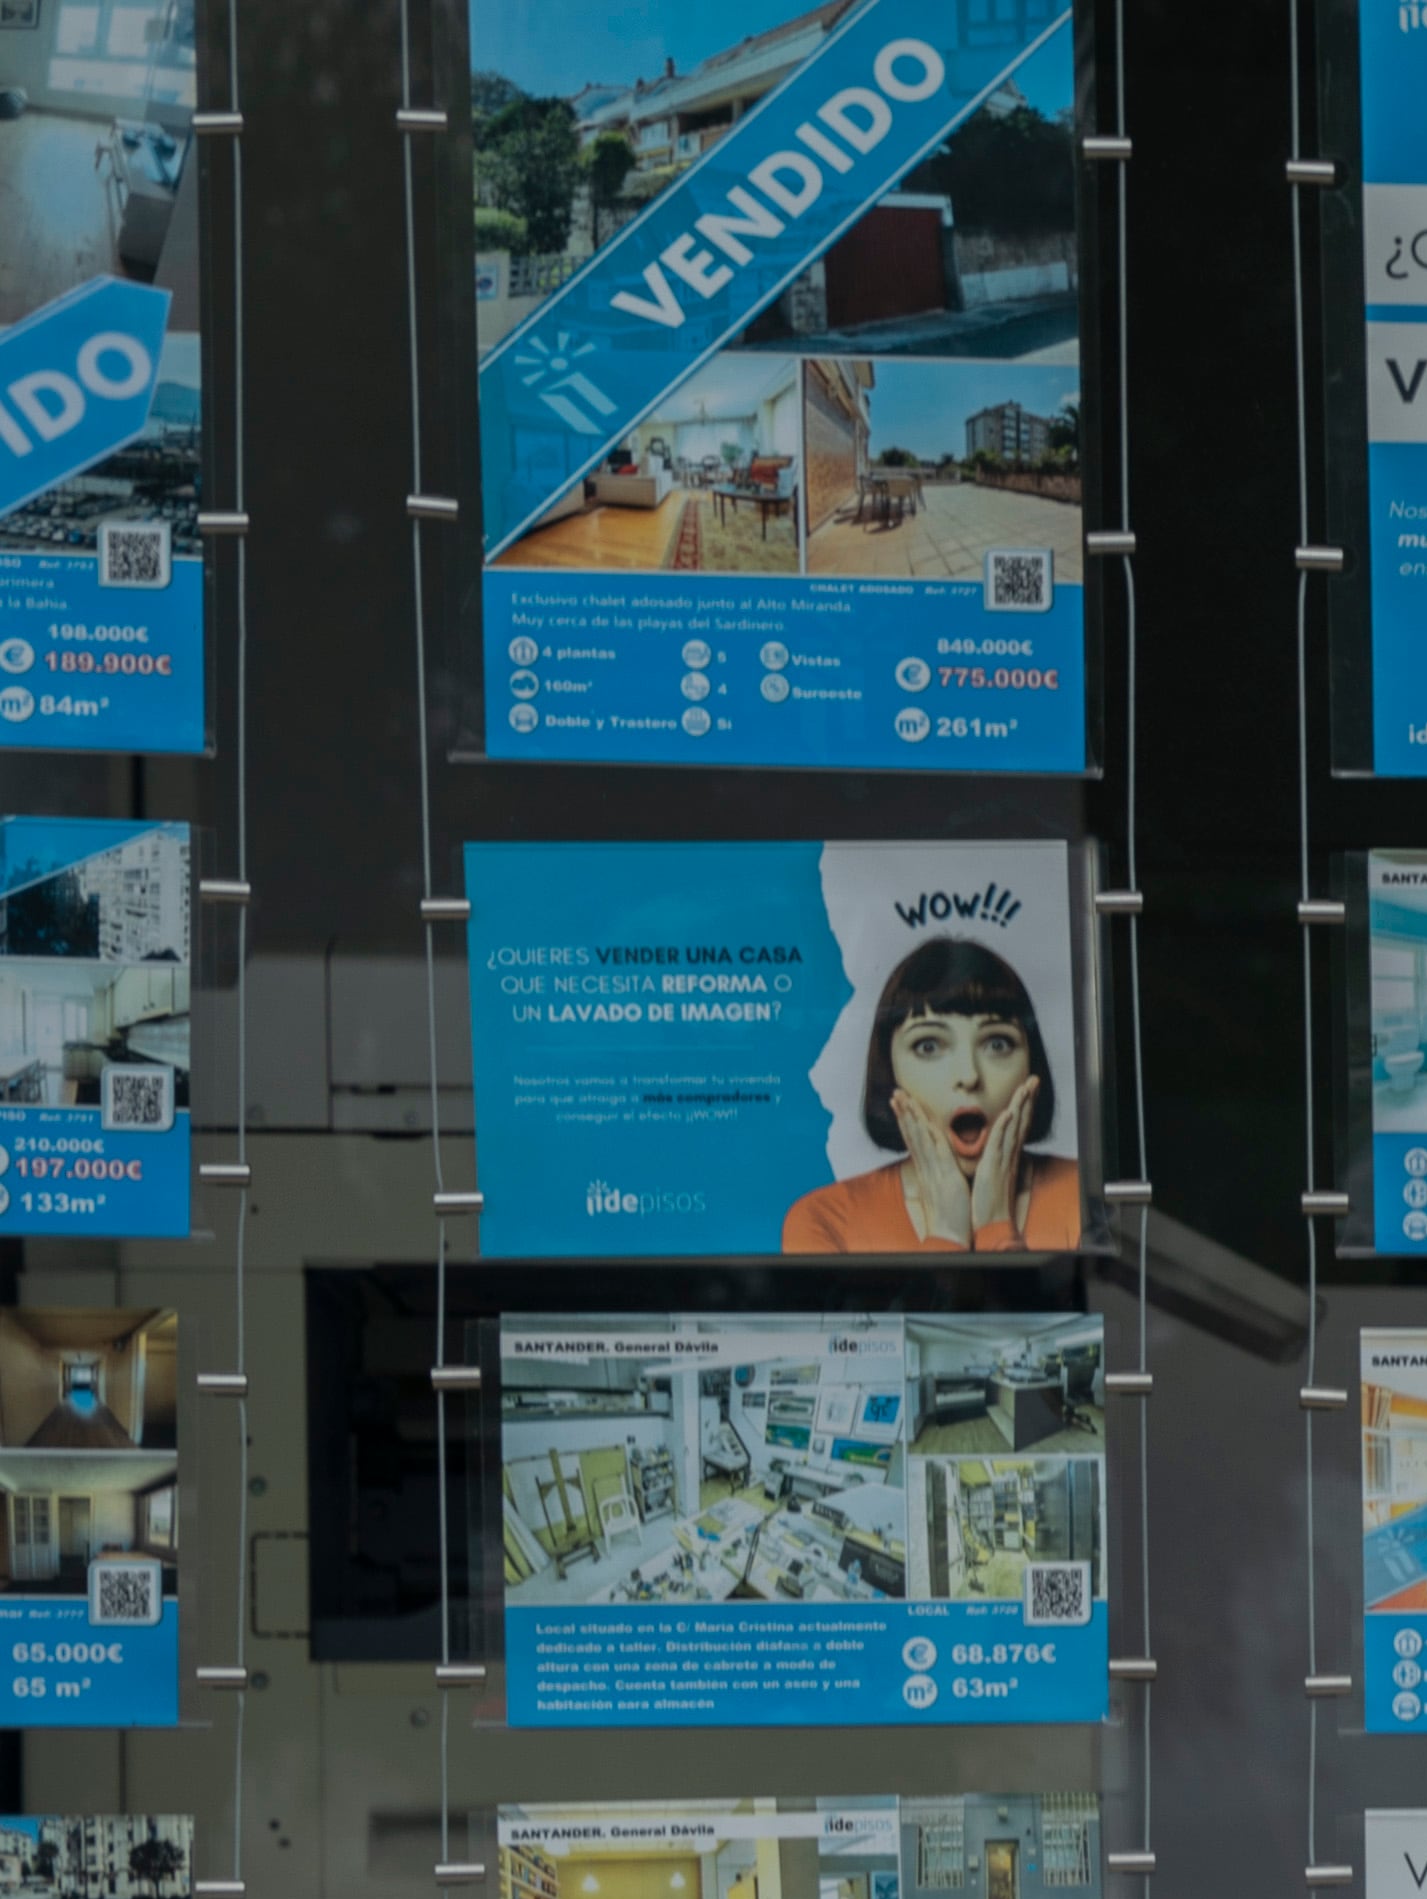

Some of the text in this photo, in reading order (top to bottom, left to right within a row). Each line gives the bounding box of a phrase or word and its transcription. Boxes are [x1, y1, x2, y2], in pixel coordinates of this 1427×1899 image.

[609, 38, 945, 329] VENDIDO
[512, 613, 785, 633] Muy cerca de las playas del Sardinero.
[542, 647, 616, 662] 4 plantas
[937, 639, 1032, 655] 849.000€
[45, 652, 172, 676] 189.900€
[792, 653, 841, 667] Vistas
[938, 668, 1059, 690] 775.000€
[40, 695, 109, 716] 84m²
[545, 715, 677, 731] Doble y Trastero
[937, 718, 1018, 738] 261m²
[895, 883, 1022, 928] WOW!!!
[487, 947, 803, 970] ¿QUIERES VENDER UNA CASA
[501, 975, 792, 994] QUE NECESITA REFORMA O
[513, 1001, 782, 1022] UN LAVADO DE IMAGEN?
[14, 1137, 104, 1153] 210.000€
[17, 1158, 142, 1180] 197.000€
[20, 1192, 106, 1214] 133m²
[515, 1340, 718, 1354] SANTANDER. General Dávila
[908, 1606, 949, 1617] LOCAL
[13, 1643, 123, 1663] 65.000€
[952, 1644, 1056, 1664] 68.876€
[13, 1676, 92, 1697] 65 m²
[952, 1678, 1018, 1699] 63m²
[511, 1824, 714, 1841] SANTANDER. General Dávila
